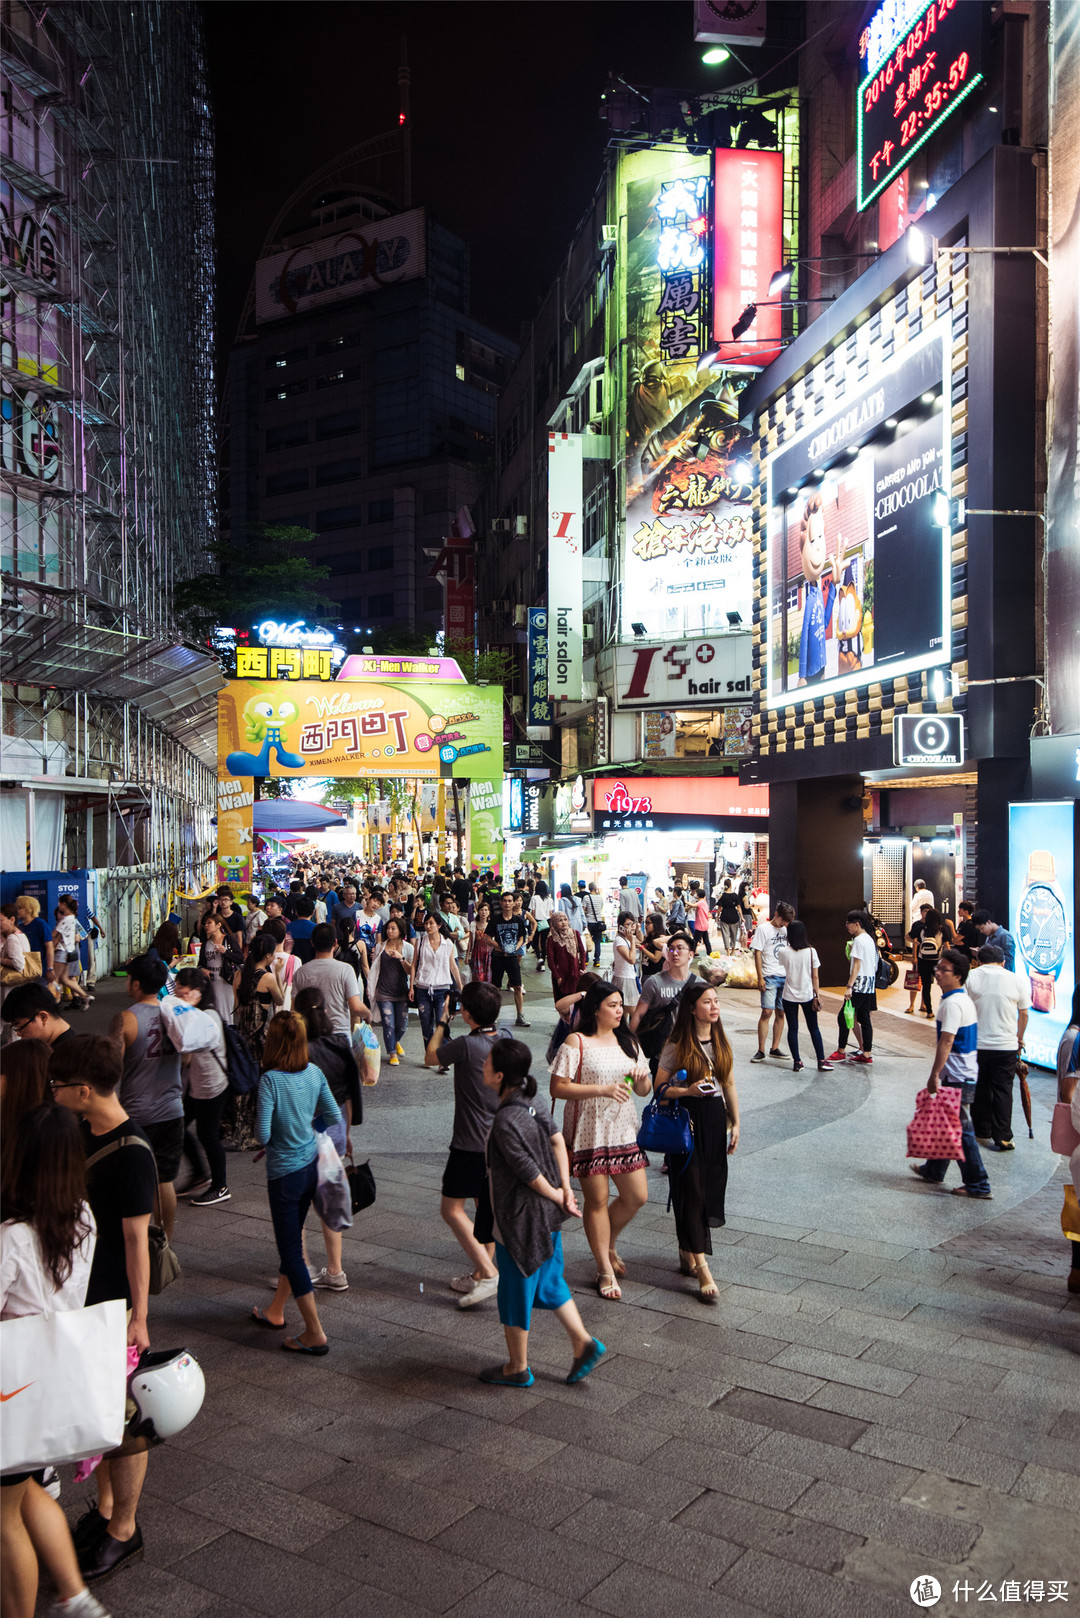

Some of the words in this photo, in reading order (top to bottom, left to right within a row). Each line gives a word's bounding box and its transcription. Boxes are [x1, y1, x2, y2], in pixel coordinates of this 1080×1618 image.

[893, 51, 939, 118] 星期六
[868, 140, 896, 181] 下午
[900, 51, 970, 147] 22:35:59
[683, 553, 732, 568] 全新改版
[557, 607, 573, 638] hair
[236, 646, 334, 681] 西門町
[362, 658, 400, 673] Xi-Men
[402, 660, 440, 674] Walker
[557, 641, 569, 684] salon
[688, 677, 722, 695] hair
[727, 675, 753, 692] sal
[305, 692, 385, 718] Welcome
[299, 709, 410, 755] 西門町
[309, 752, 366, 767] XIMEN-WALKER
[530, 798, 539, 830] TOUGH
[57, 884, 80, 892] STOP
